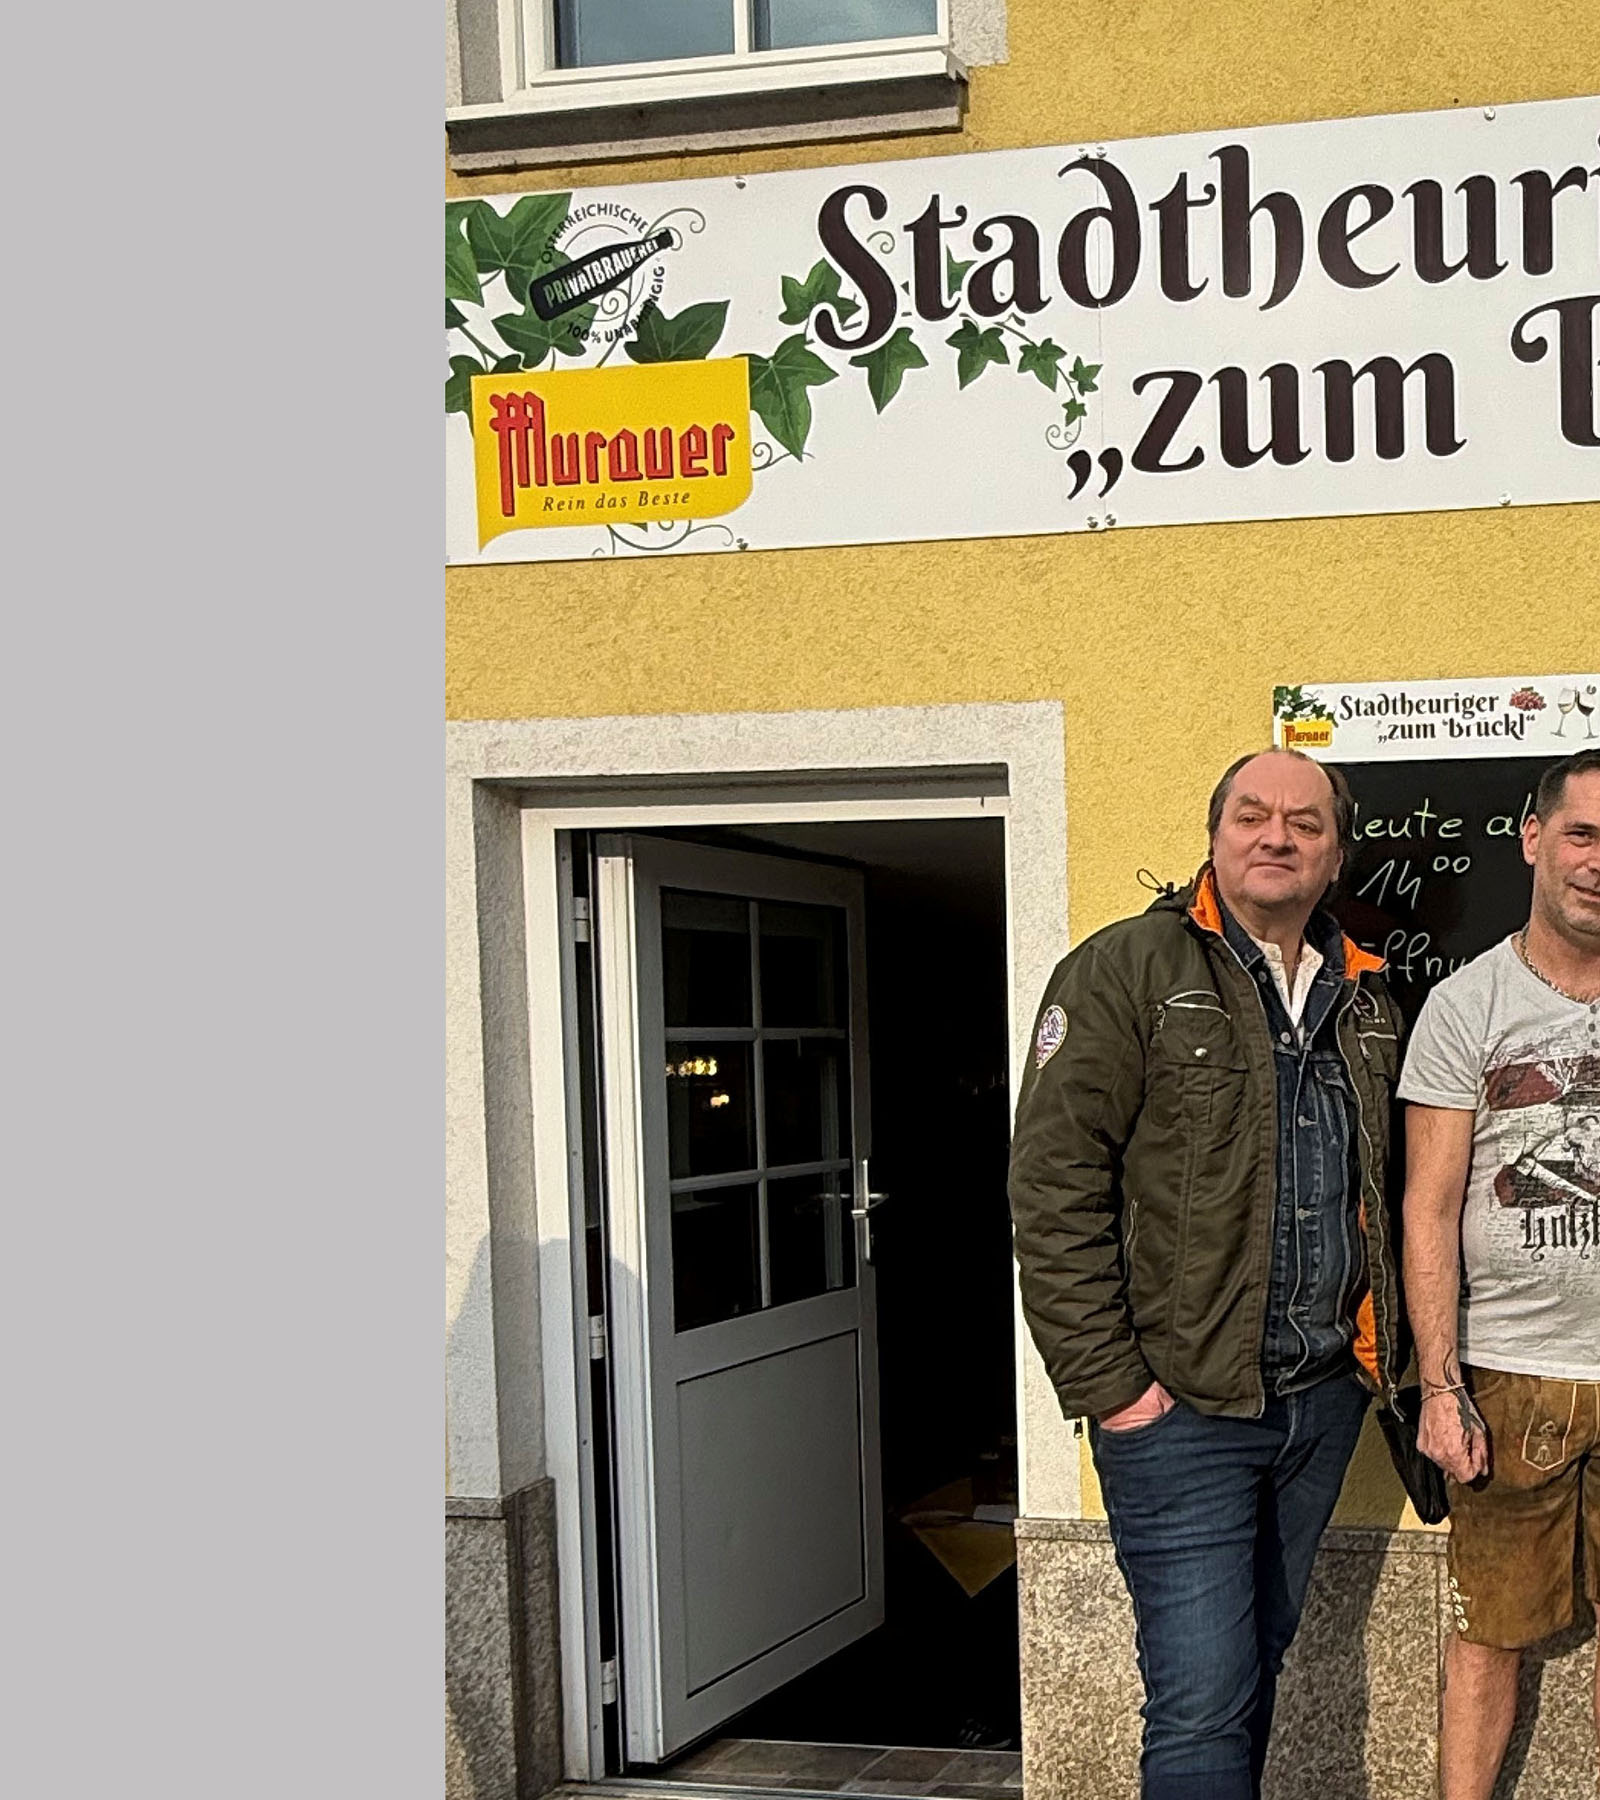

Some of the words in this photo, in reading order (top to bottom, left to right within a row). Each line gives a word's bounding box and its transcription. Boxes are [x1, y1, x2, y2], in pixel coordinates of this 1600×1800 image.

[543, 239, 659, 308] PRIVATBRAUEREI
[489, 391, 735, 517] Murauer
[543, 494, 586, 512] Rein
[595, 492, 628, 510] das
[638, 490, 691, 508] Beste
[1340, 692, 1500, 721] Stadtheuriger
